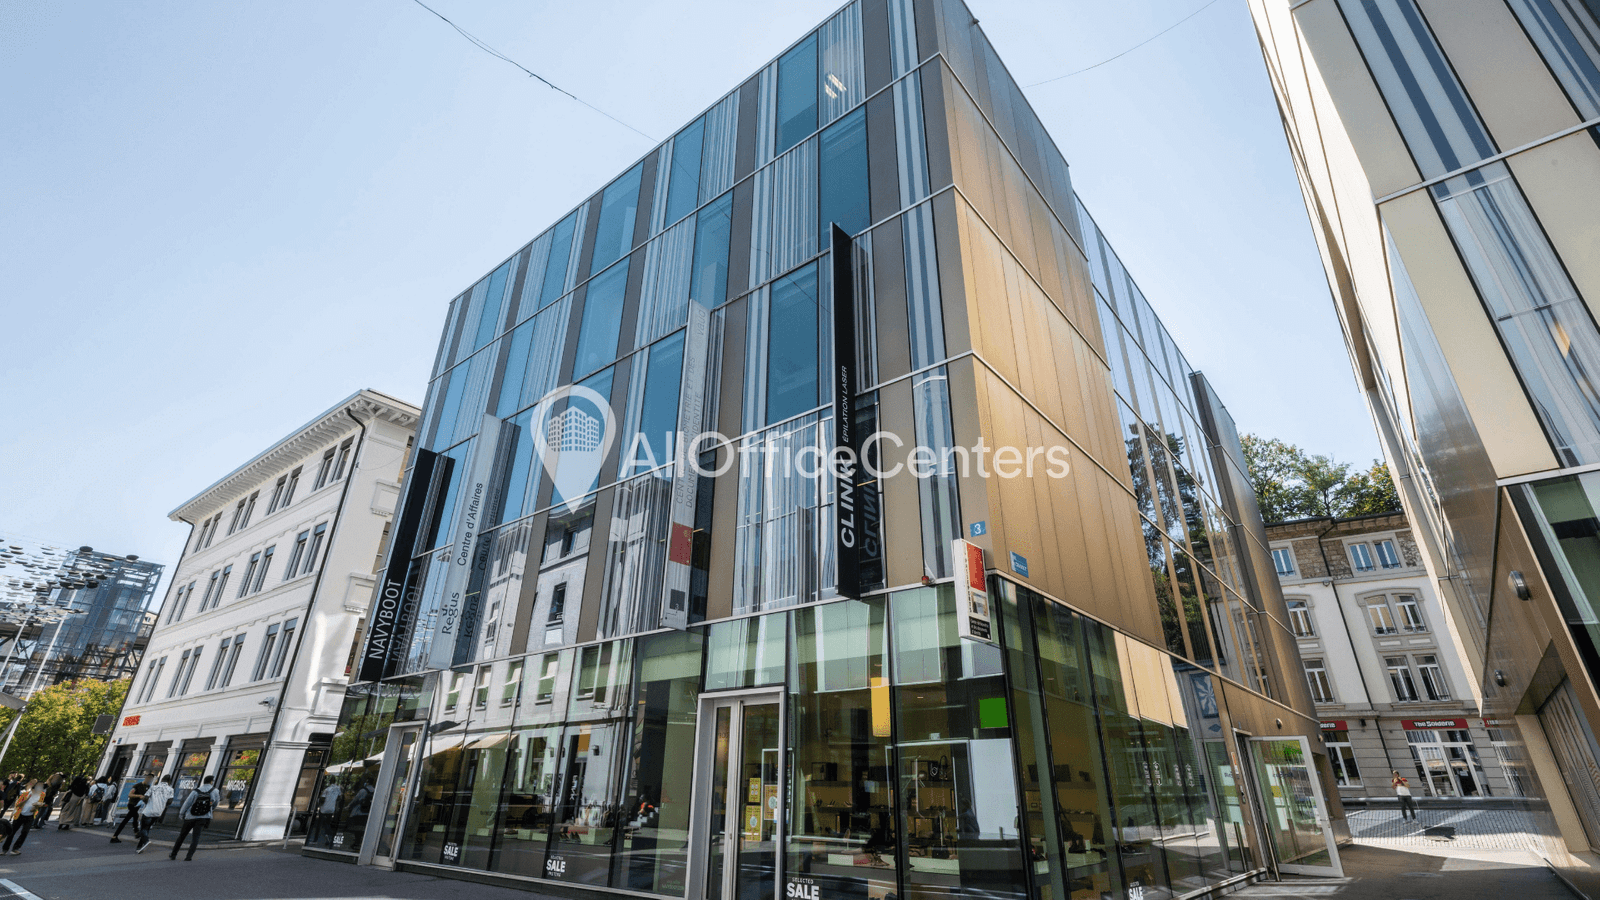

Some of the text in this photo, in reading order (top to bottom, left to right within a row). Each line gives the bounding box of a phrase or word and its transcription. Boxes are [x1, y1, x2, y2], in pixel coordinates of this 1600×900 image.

[697, 309, 706, 336] vaud
[686, 376, 694, 390] ET
[840, 455, 856, 549] CLINIK
[457, 483, 483, 566] Centre d'Affaires
[974, 523, 982, 535] 3
[368, 579, 402, 660] NAVYBOOT
[441, 592, 460, 635] Regus
[443, 845, 458, 857] SALE
[546, 859, 566, 873] SALE
[786, 882, 820, 900] SALE
